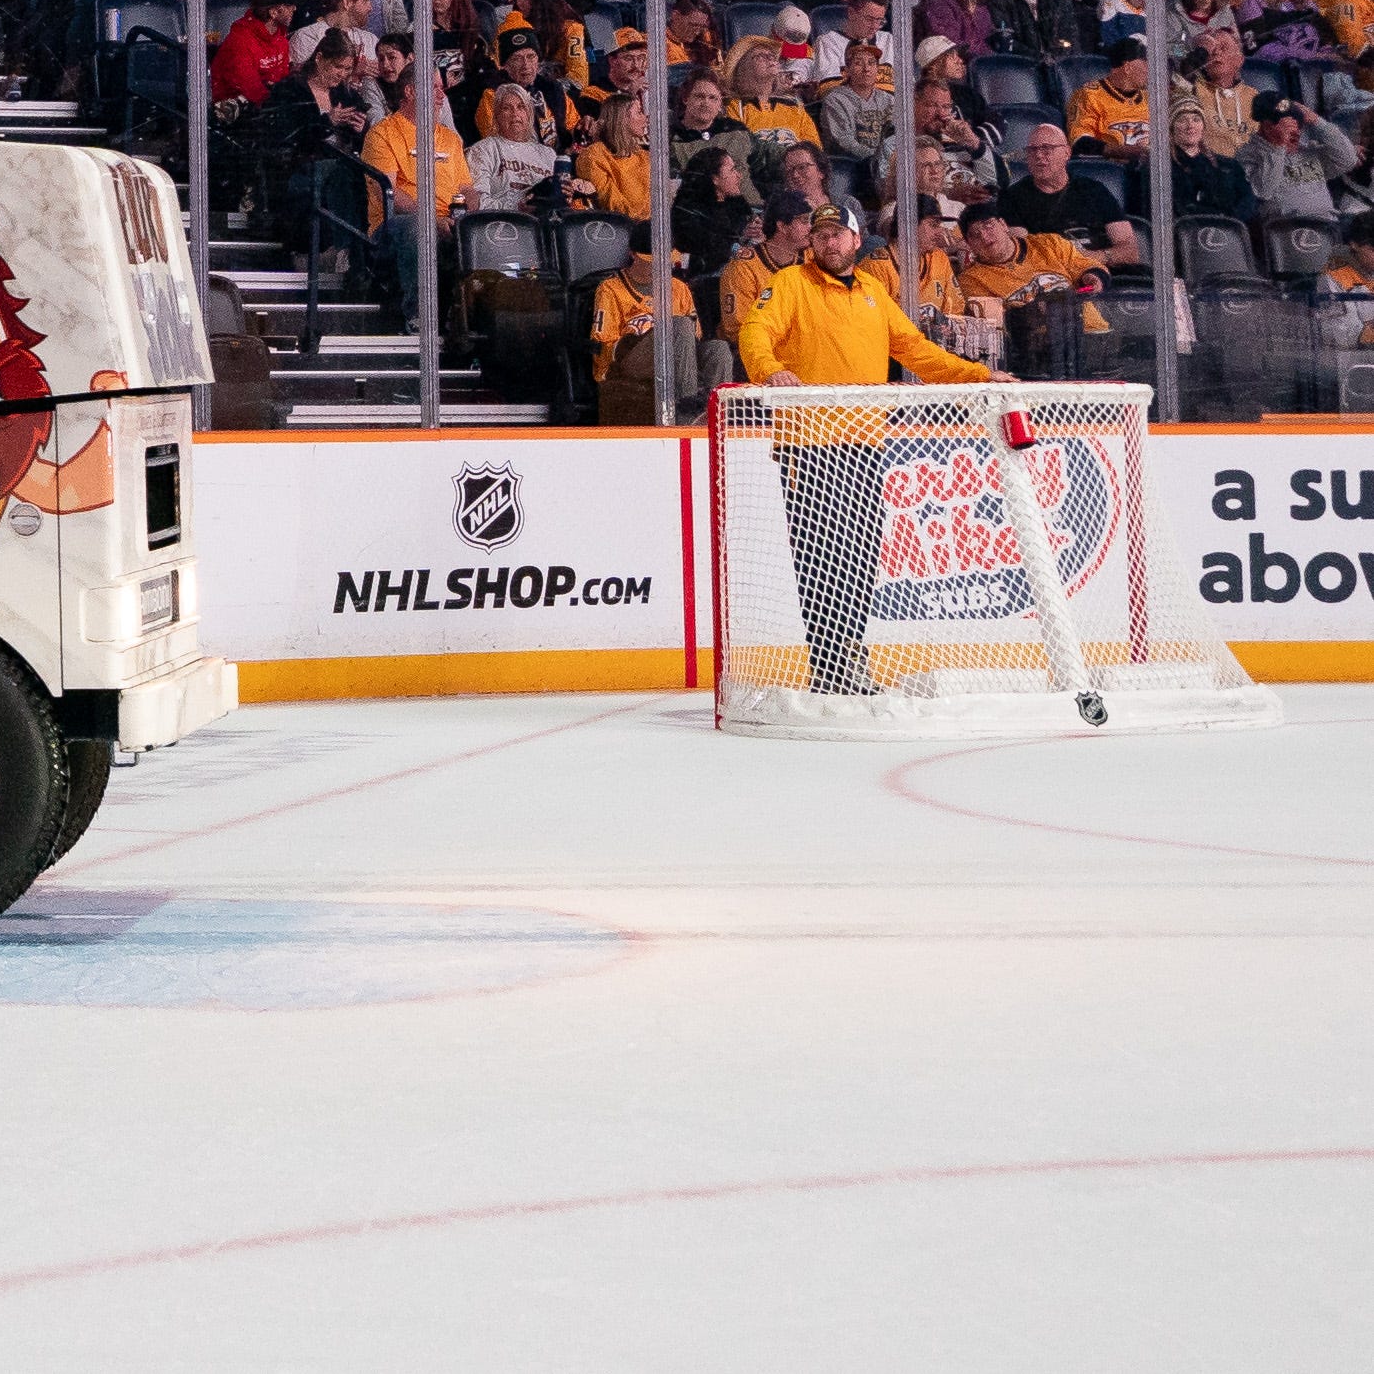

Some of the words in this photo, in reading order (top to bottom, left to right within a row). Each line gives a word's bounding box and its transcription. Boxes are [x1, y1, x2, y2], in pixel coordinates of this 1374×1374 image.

[467, 487, 511, 534] NHL
[1211, 469, 1256, 521] a
[1289, 469, 1374, 521] su
